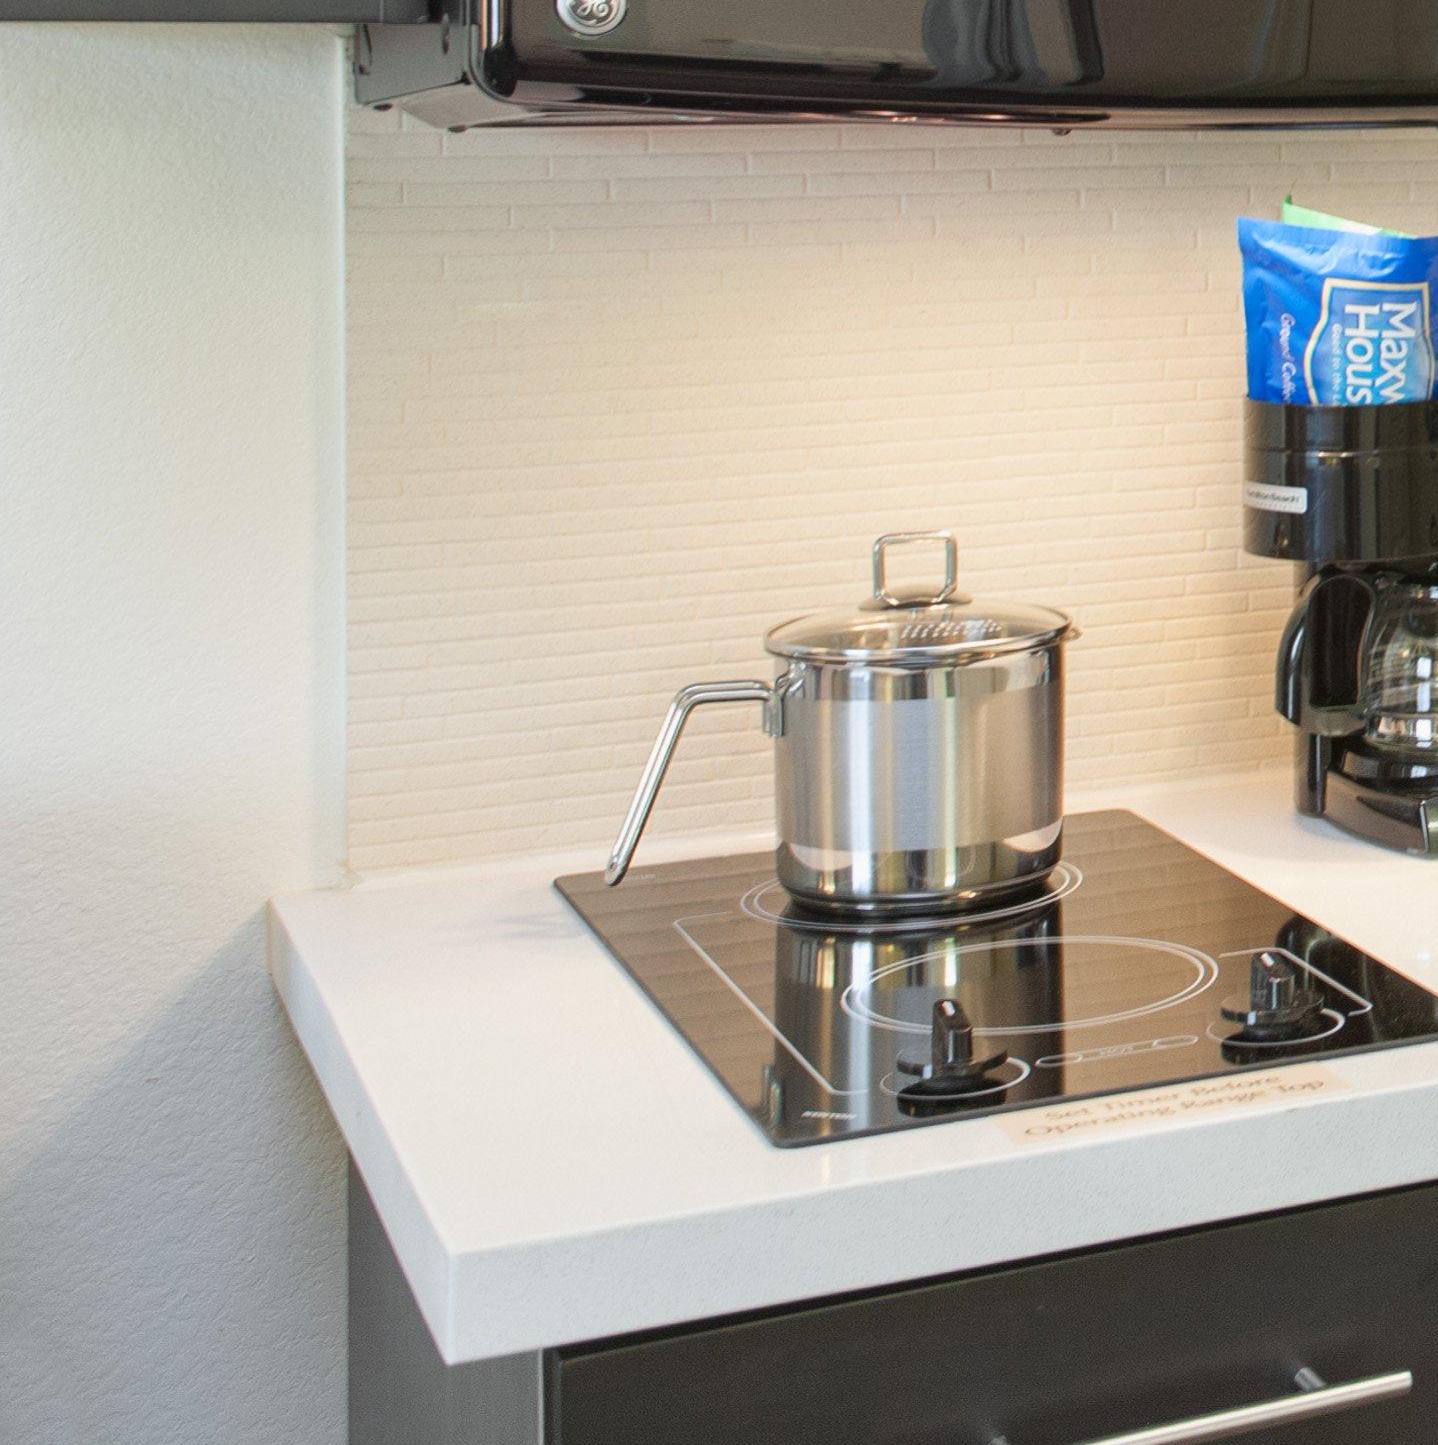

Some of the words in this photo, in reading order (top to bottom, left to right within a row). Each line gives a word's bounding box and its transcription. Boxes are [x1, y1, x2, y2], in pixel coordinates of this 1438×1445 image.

[1344, 303, 1380, 407] Hous
[1025, 1105, 1176, 1136] Operating
[1181, 1089, 1265, 1110] Range
[1277, 1079, 1325, 1094] Top
[1046, 1108, 1090, 1120] Set
[1104, 1092, 1180, 1110] Timer
[1190, 1075, 1280, 1096] Before
